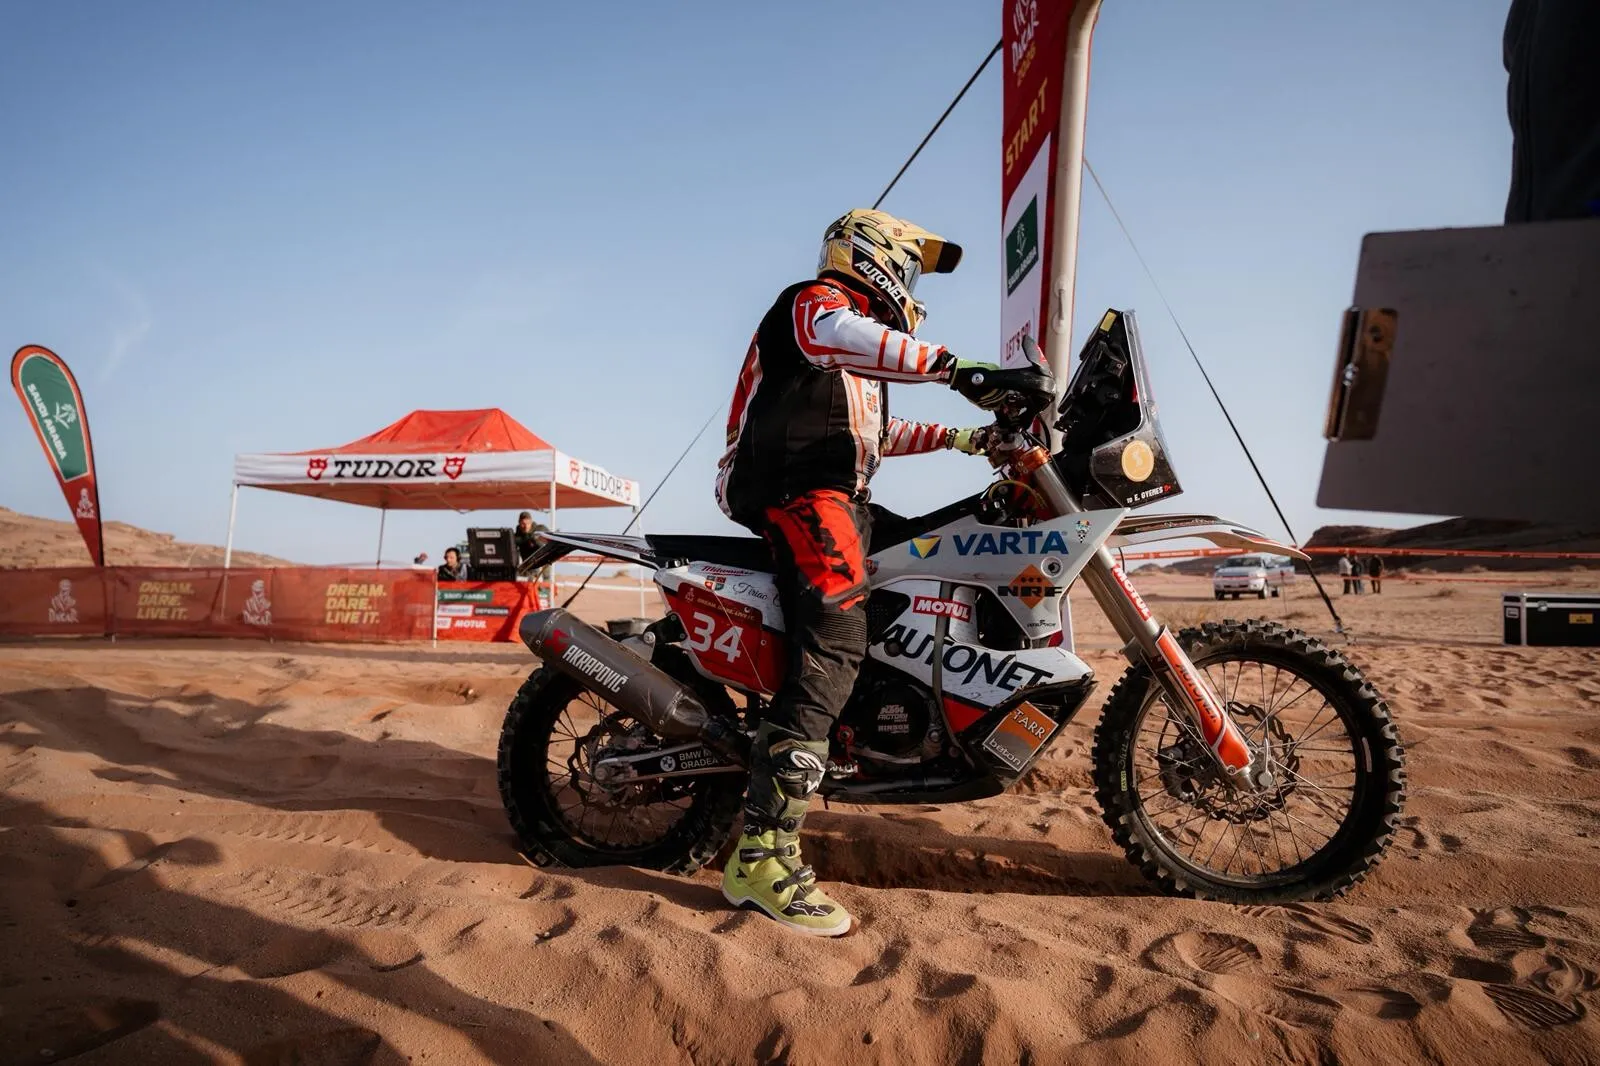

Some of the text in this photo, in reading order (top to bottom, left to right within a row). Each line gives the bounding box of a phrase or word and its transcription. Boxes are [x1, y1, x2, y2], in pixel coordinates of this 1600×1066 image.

[1005, 77, 1048, 176] START
[854, 260, 907, 305] AUTONET
[27, 383, 68, 460] SAUDI ARABIA
[334, 459, 437, 478] TUDOR
[583, 466, 624, 497] TUDOR
[953, 530, 1069, 556] VARTA
[139, 581, 195, 594] DREAM.
[326, 583, 387, 597] DREAM.
[998, 585, 1064, 598] NRF
[1113, 566, 1150, 618] MOTUL
[138, 594, 181, 606] DARE.
[325, 597, 372, 610] DARE.
[916, 599, 970, 620] MOTUL
[136, 607, 188, 620] LIVE IT.
[325, 611, 380, 624] LIVE IT.
[454, 619, 487, 629] MOTUL
[689, 611, 743, 663] 34
[882, 623, 1054, 692] AUTONET
[562, 644, 629, 693] AKRAPOVIČ
[1013, 708, 1045, 738] TARR
[679, 749, 701, 761] BMW
[680, 756, 719, 769] ORADEA
[989, 739, 1021, 766] beton
